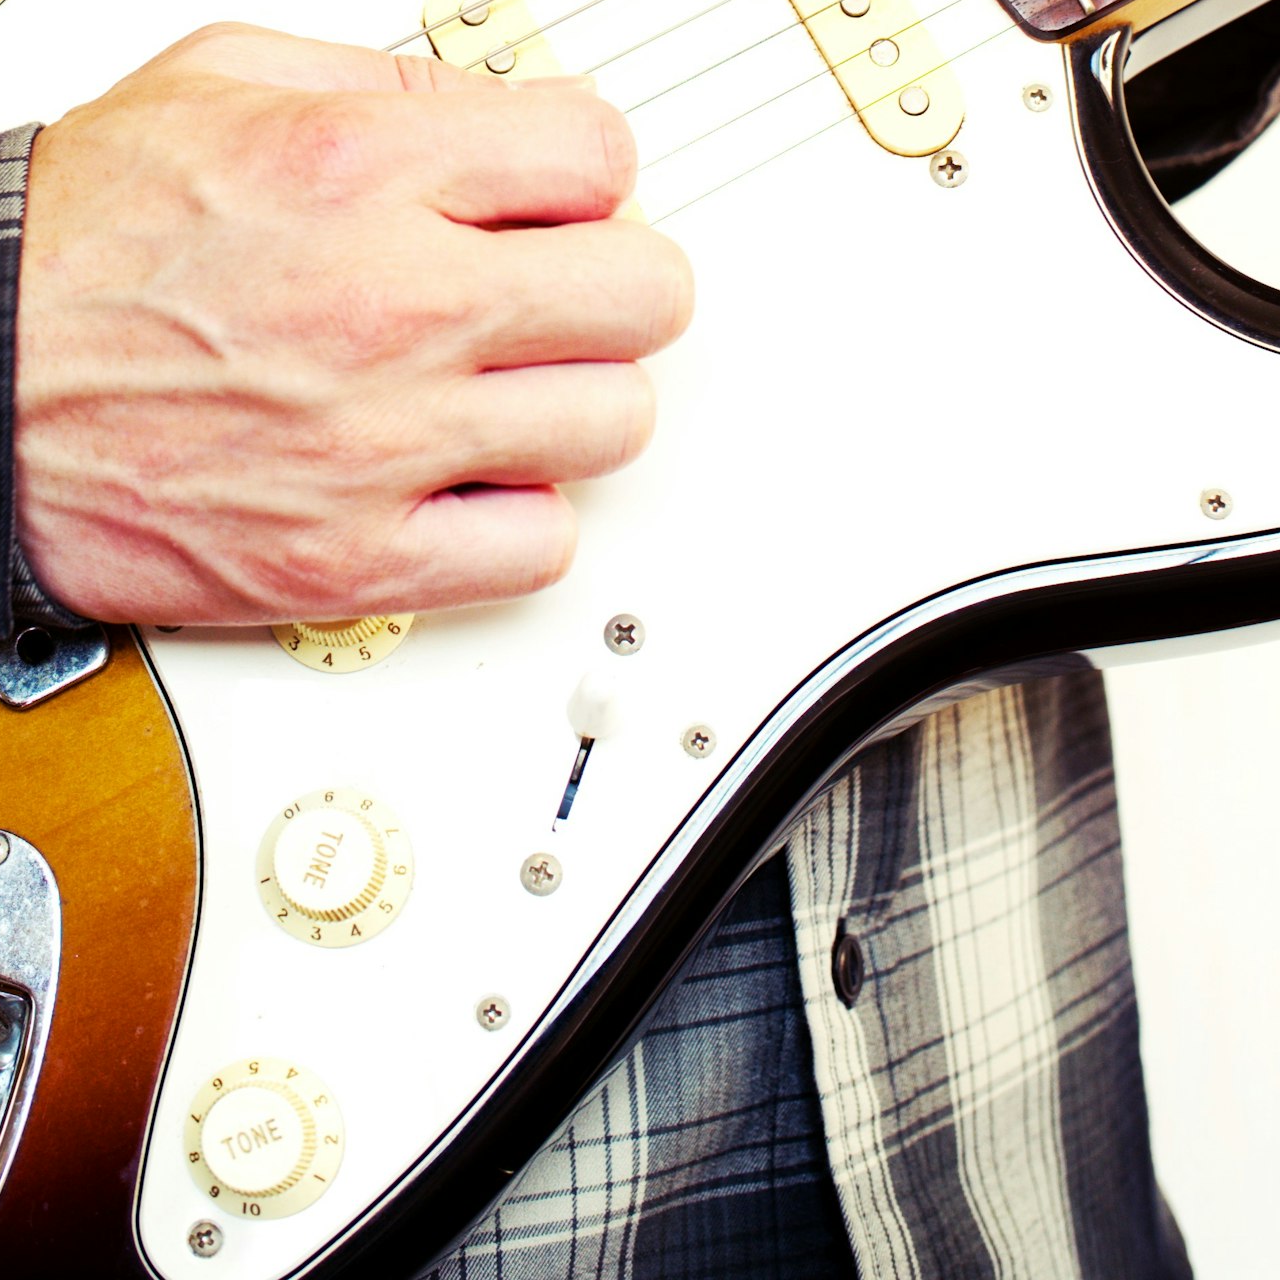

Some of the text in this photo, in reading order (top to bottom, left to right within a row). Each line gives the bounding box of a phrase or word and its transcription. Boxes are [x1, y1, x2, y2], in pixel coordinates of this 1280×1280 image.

[288, 636, 300, 651] 3
[322, 653, 333, 666] 4
[359, 647, 371, 660] 5
[284, 803, 300, 819] 10
[360, 799, 373, 810] 8
[385, 828, 399, 838] 7
[304, 832, 343, 889] TONE
[379, 900, 393, 913] 5
[277, 908, 288, 922] 2
[311, 927, 322, 940] 3
[350, 924, 361, 937] 4
[249, 1062, 259, 1075] 5
[286, 1067, 298, 1079] 4
[314, 1094, 328, 1108] 3
[191, 1113, 202, 1123] 7
[220, 1118, 282, 1159] TONE
[325, 1135, 339, 1144] 2
[189, 1152, 199, 1163] 8
[242, 1202, 261, 1216] 10
